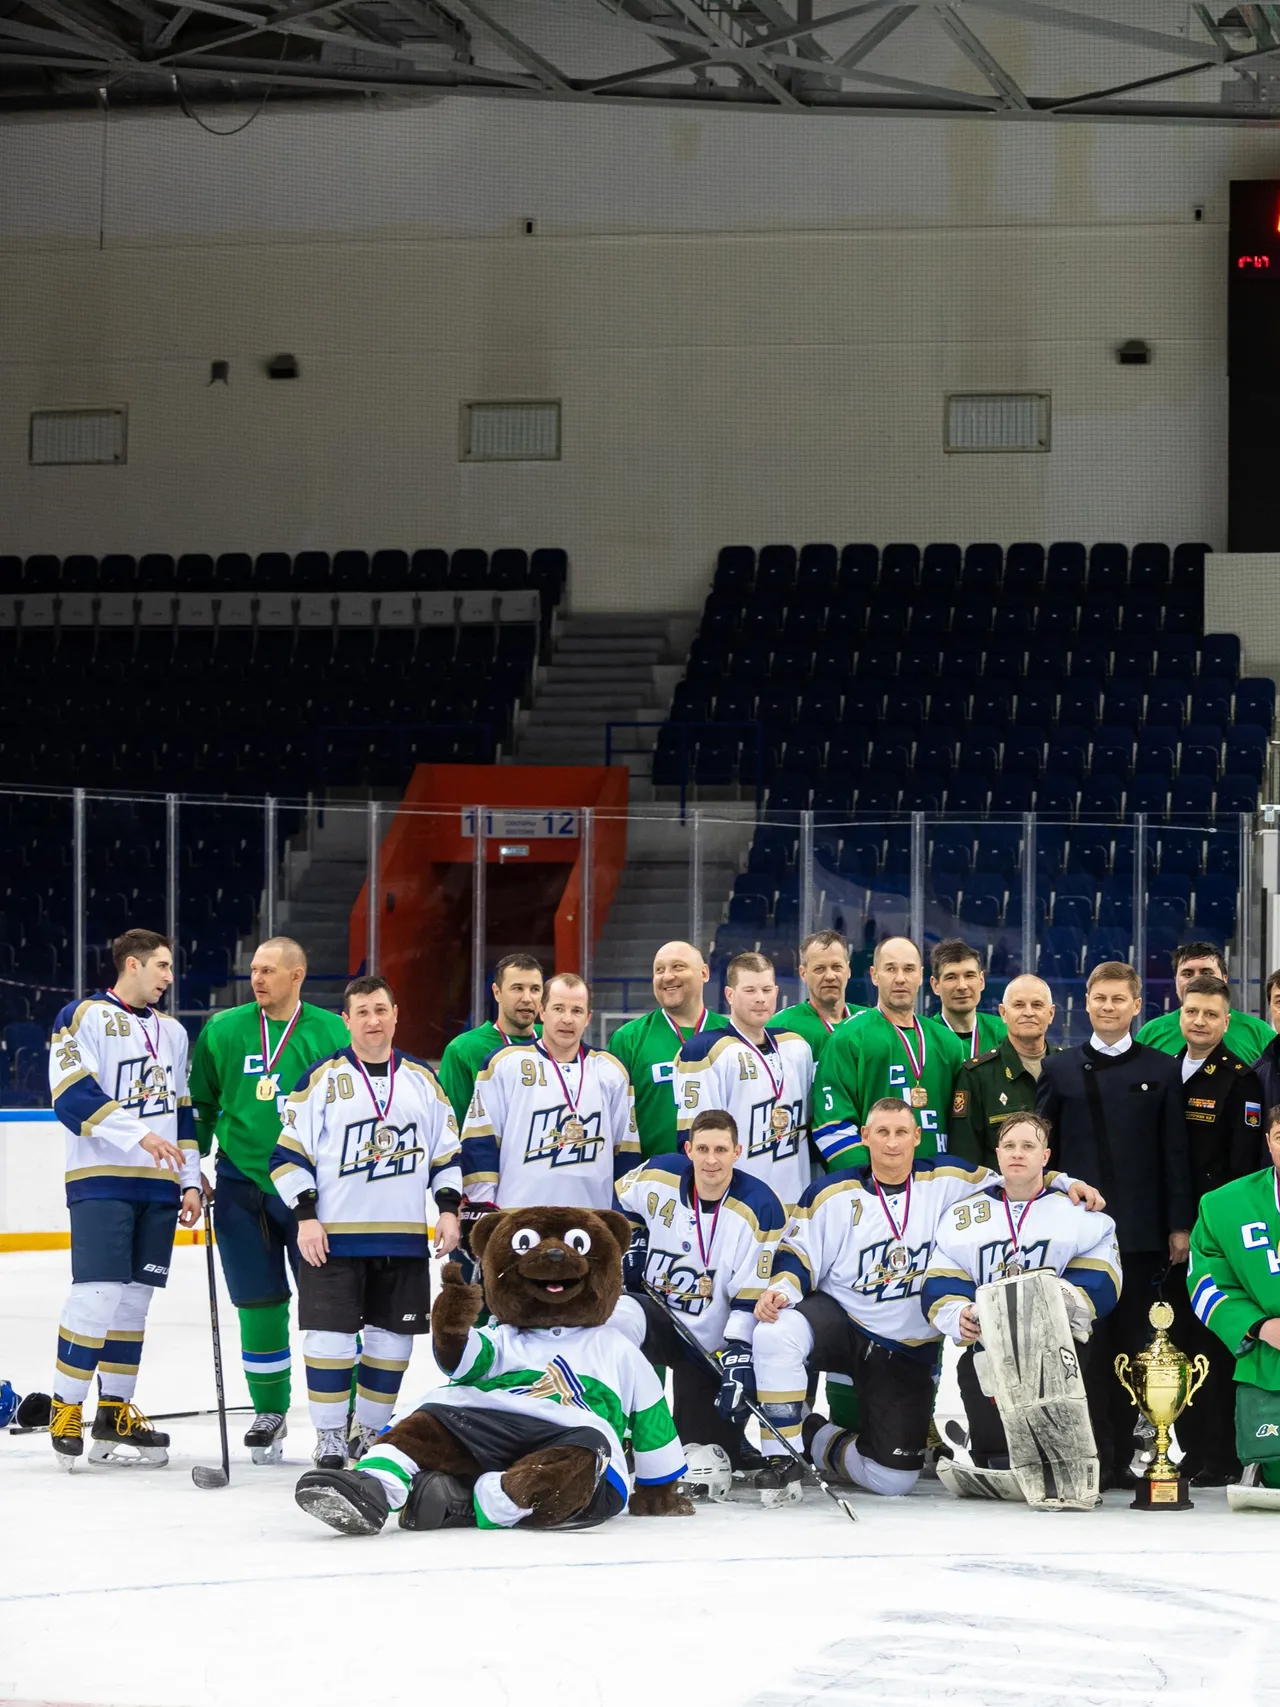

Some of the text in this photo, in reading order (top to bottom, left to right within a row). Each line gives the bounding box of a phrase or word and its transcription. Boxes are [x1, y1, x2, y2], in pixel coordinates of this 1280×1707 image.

[542, 811, 575, 835] 12
[102, 1009, 131, 1037] 26
[520, 1058, 547, 1087] 91
[738, 1052, 758, 1081] 15
[851, 1199, 863, 1226] 7
[954, 1200, 992, 1231] 33
[757, 1250, 773, 1280] 8
